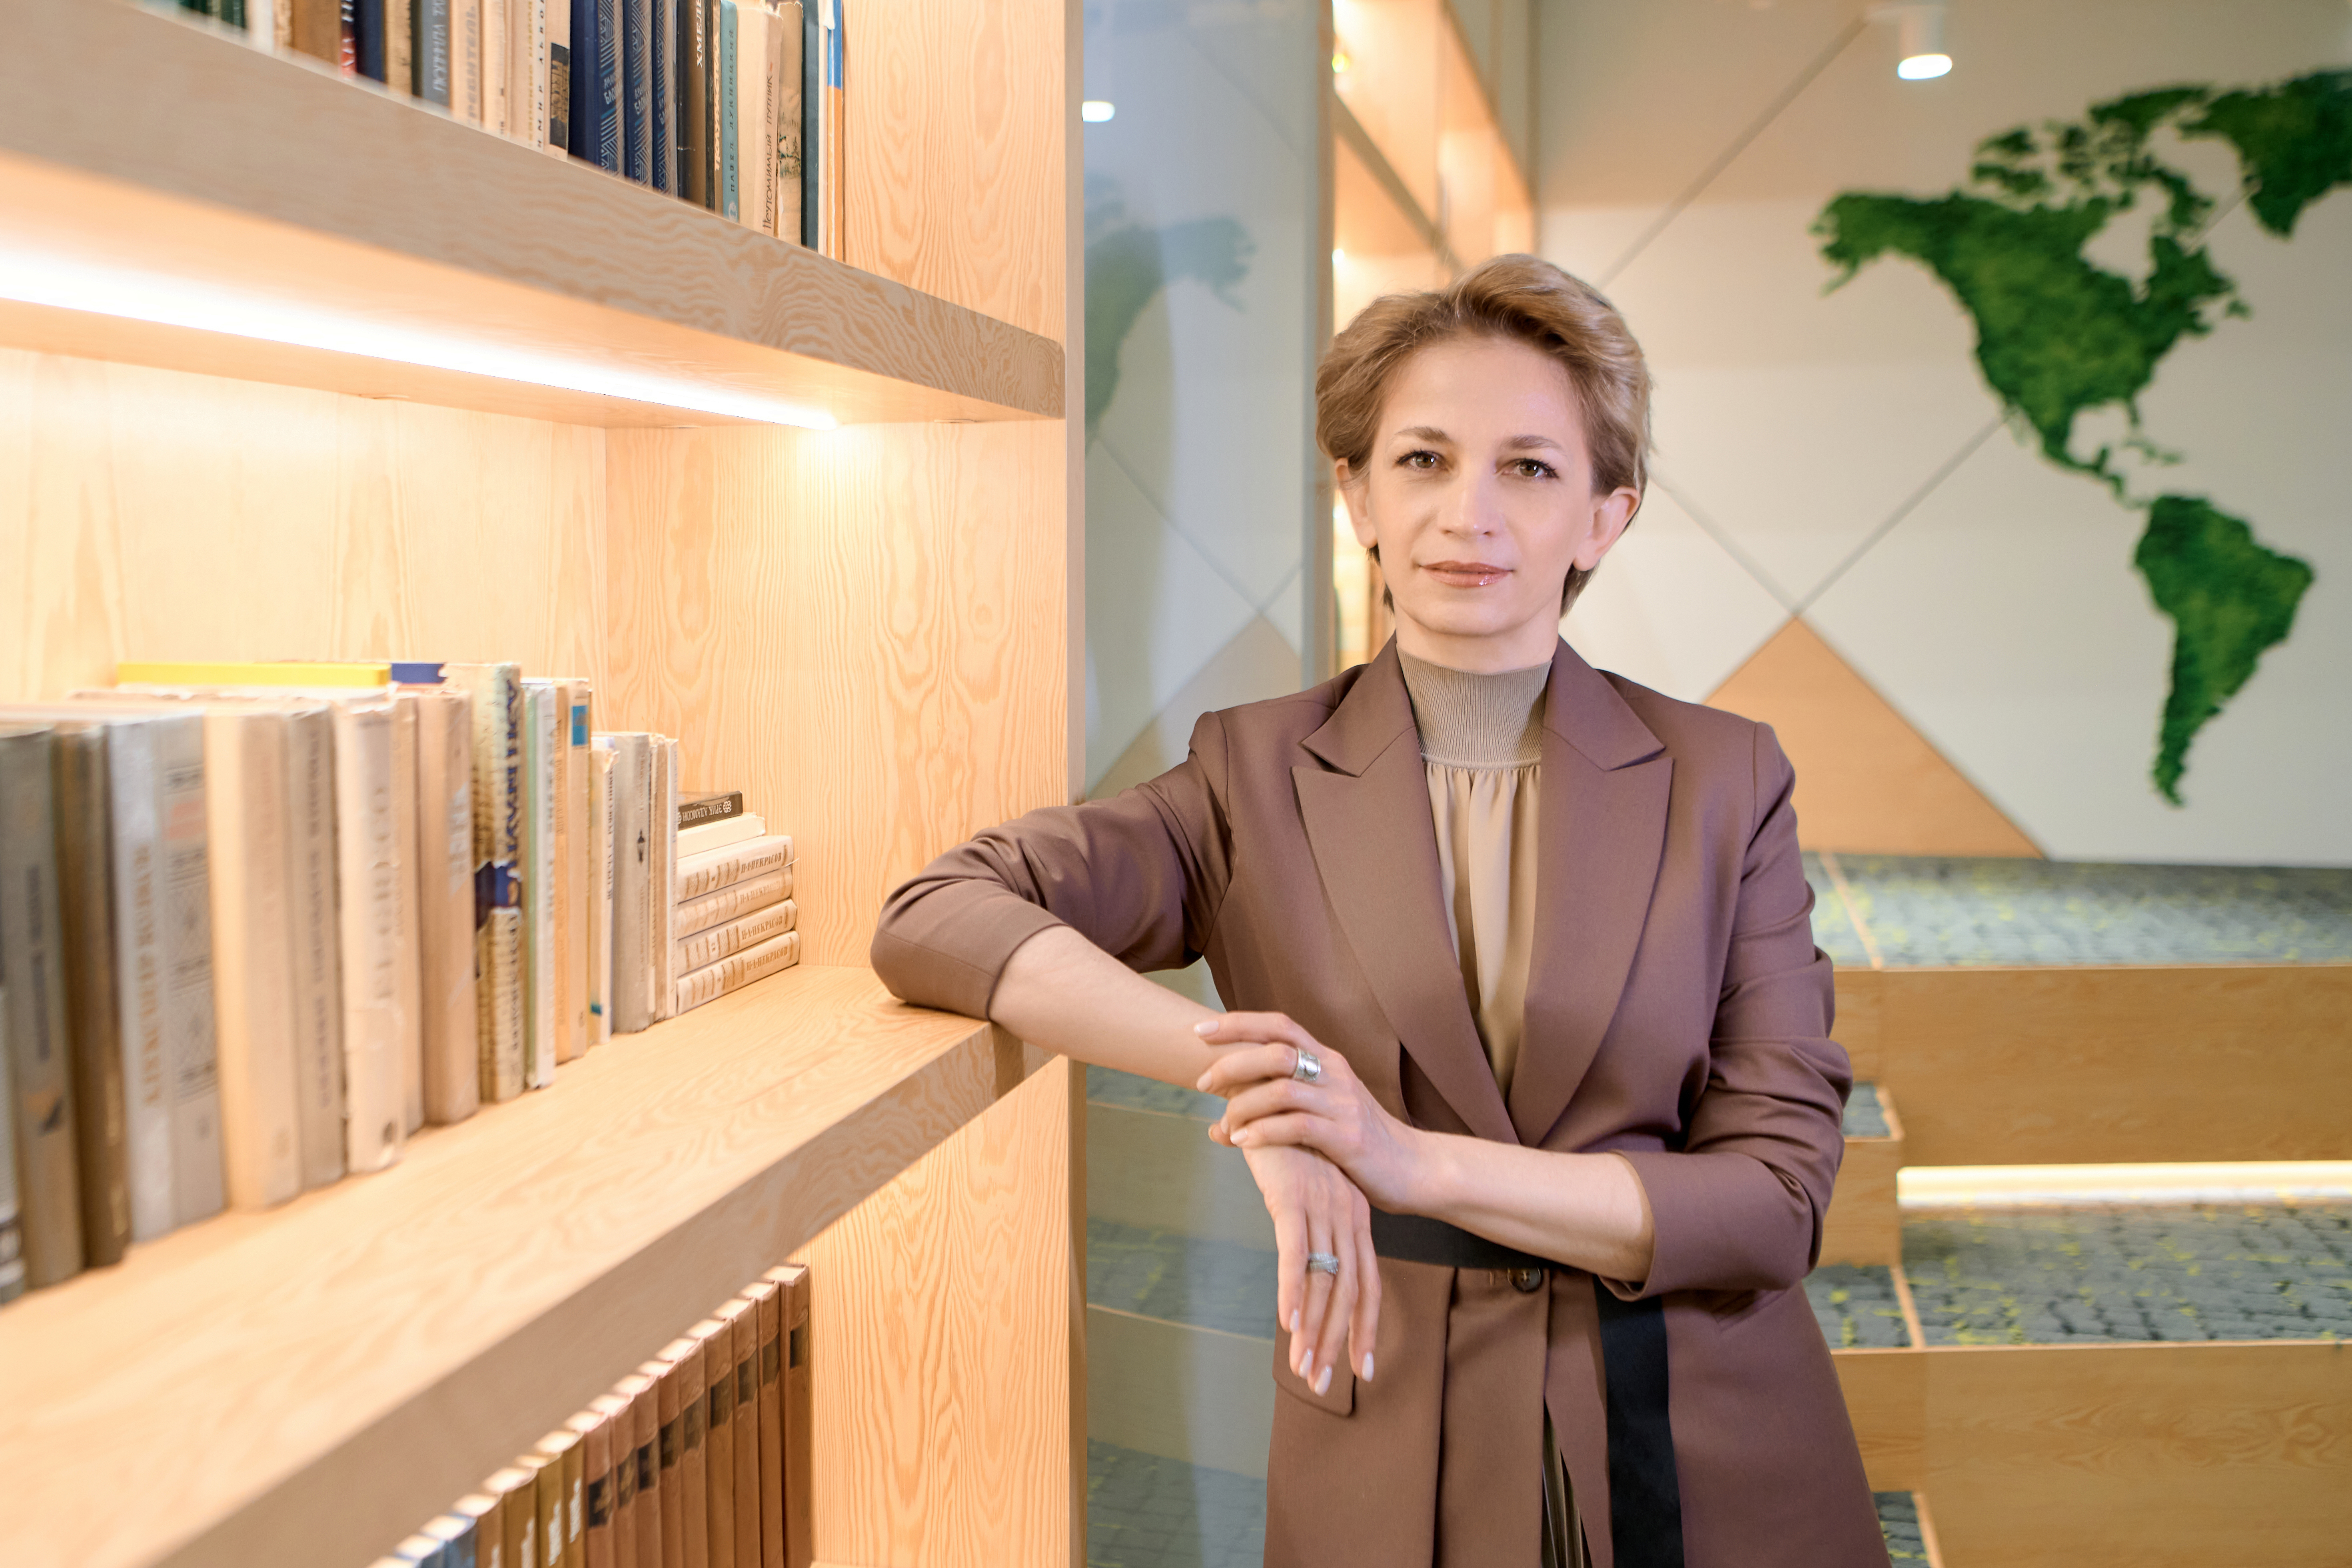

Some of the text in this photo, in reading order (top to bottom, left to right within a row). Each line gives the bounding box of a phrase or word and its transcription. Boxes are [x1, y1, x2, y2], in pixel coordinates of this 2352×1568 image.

[465, 6, 477, 120] РЕБИТЕЛЬ
[682, 804, 723, 821] ЭРИК АДАМСОН
